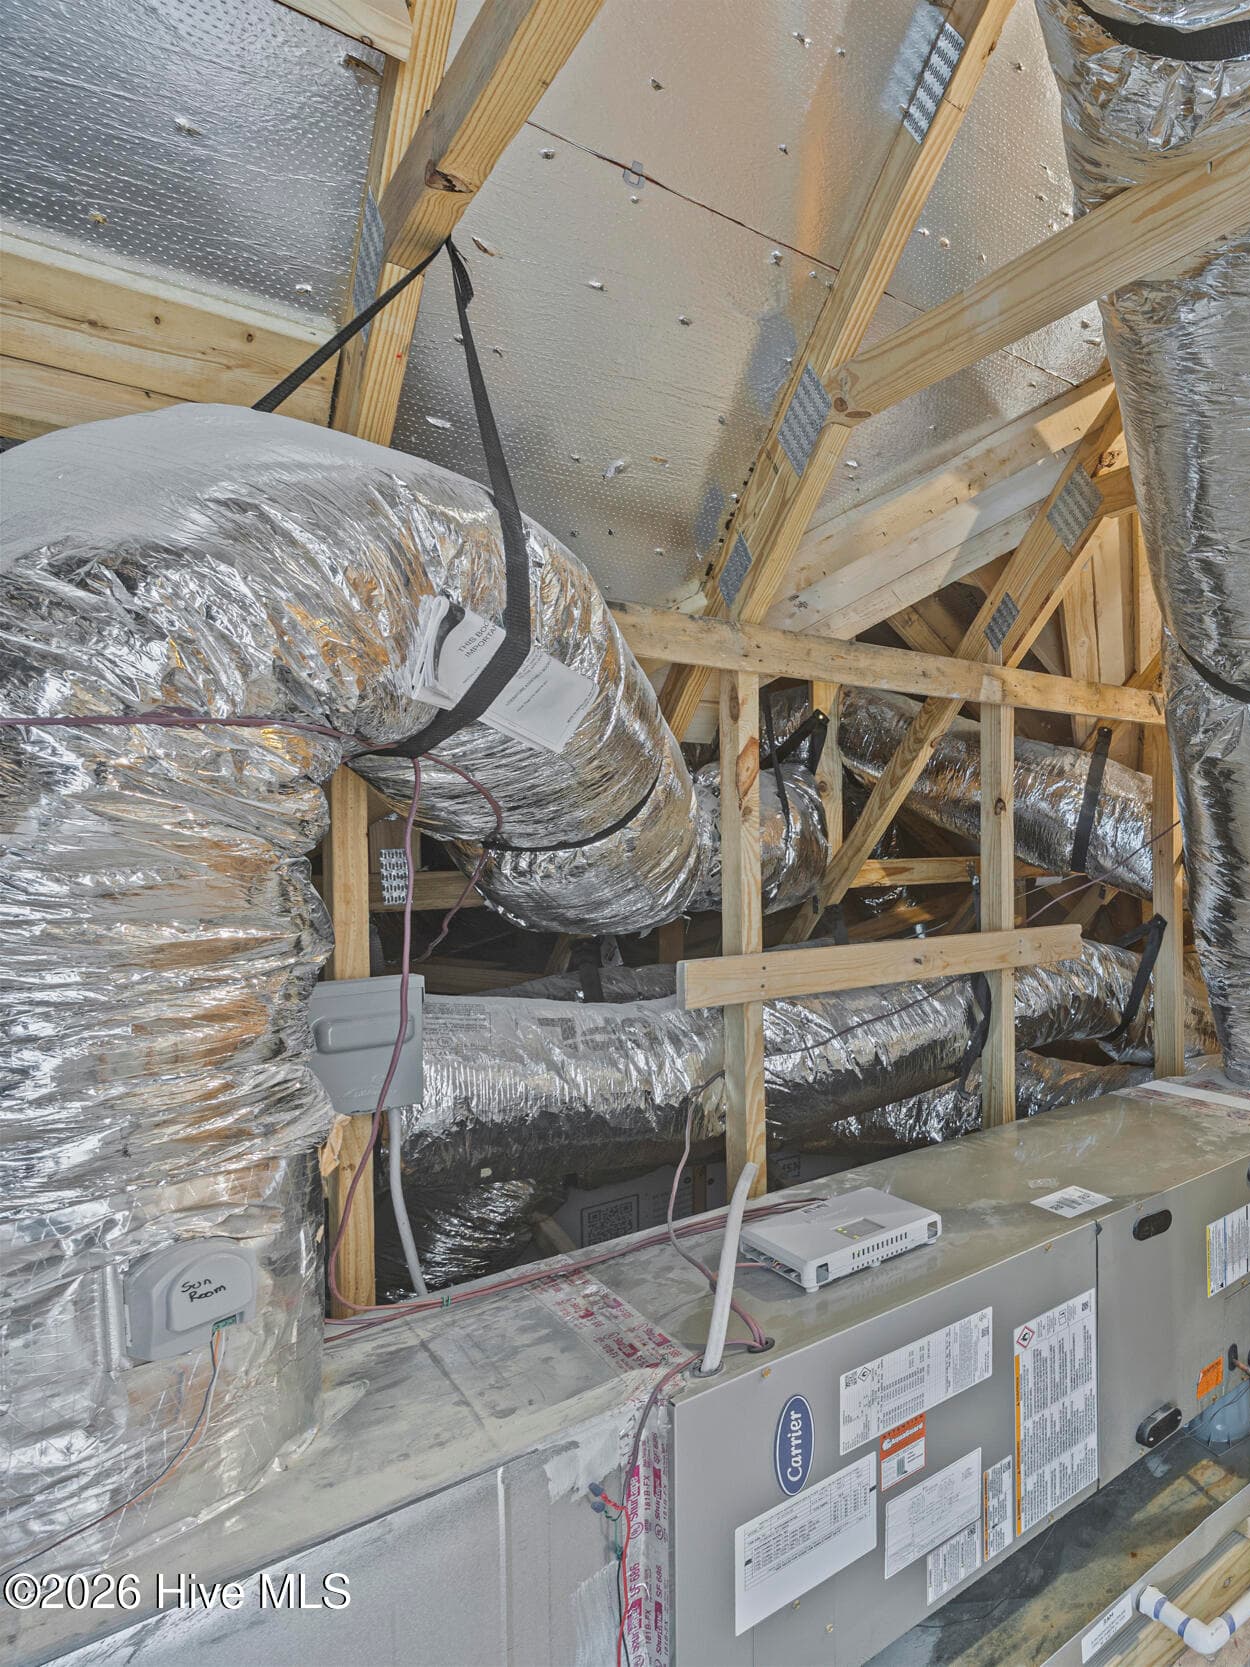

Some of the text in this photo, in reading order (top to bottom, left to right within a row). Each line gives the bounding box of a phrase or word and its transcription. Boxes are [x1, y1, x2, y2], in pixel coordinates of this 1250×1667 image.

[458, 634, 477, 652] THIS
[180, 1278, 212, 1293] Sun
[188, 1285, 227, 1303] Room
[786, 1410, 803, 1482] Carrier
